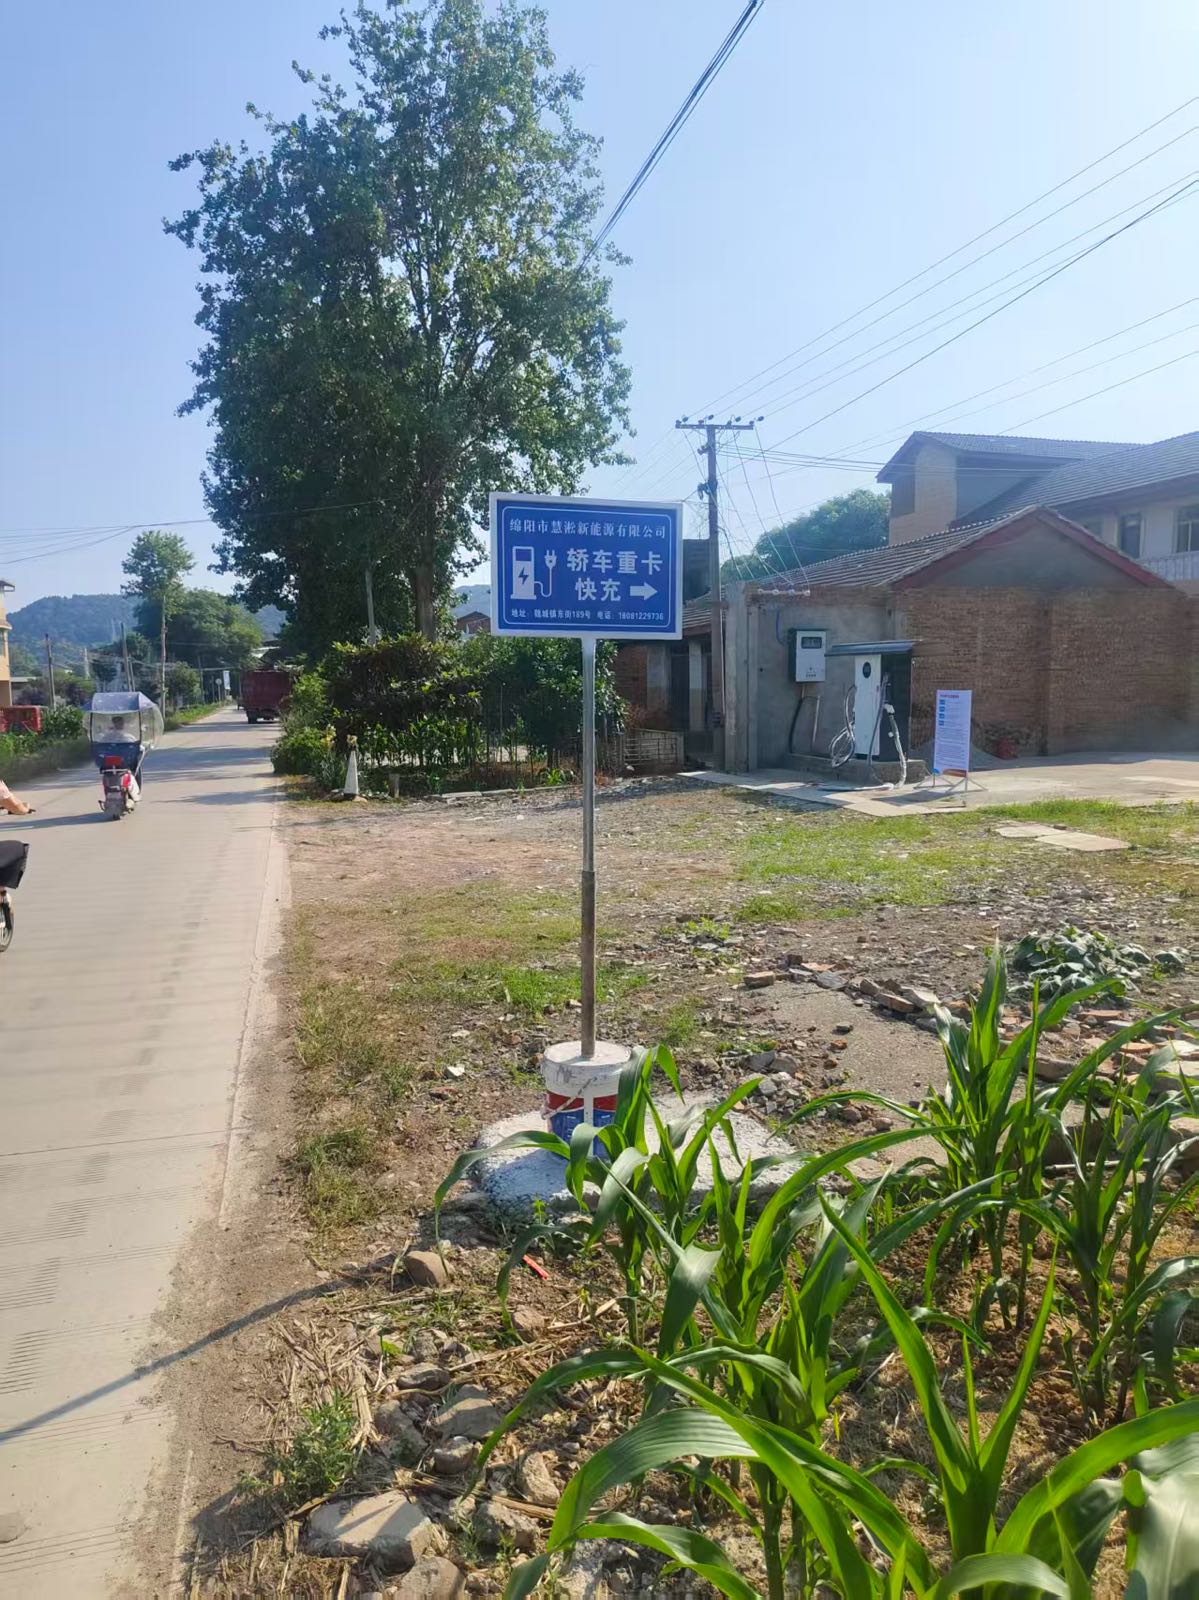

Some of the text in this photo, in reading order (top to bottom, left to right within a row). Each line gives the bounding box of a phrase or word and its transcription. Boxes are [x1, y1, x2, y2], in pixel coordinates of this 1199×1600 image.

[566, 547, 663, 575] 轿车重卡
[575, 577, 622, 601] 快充
